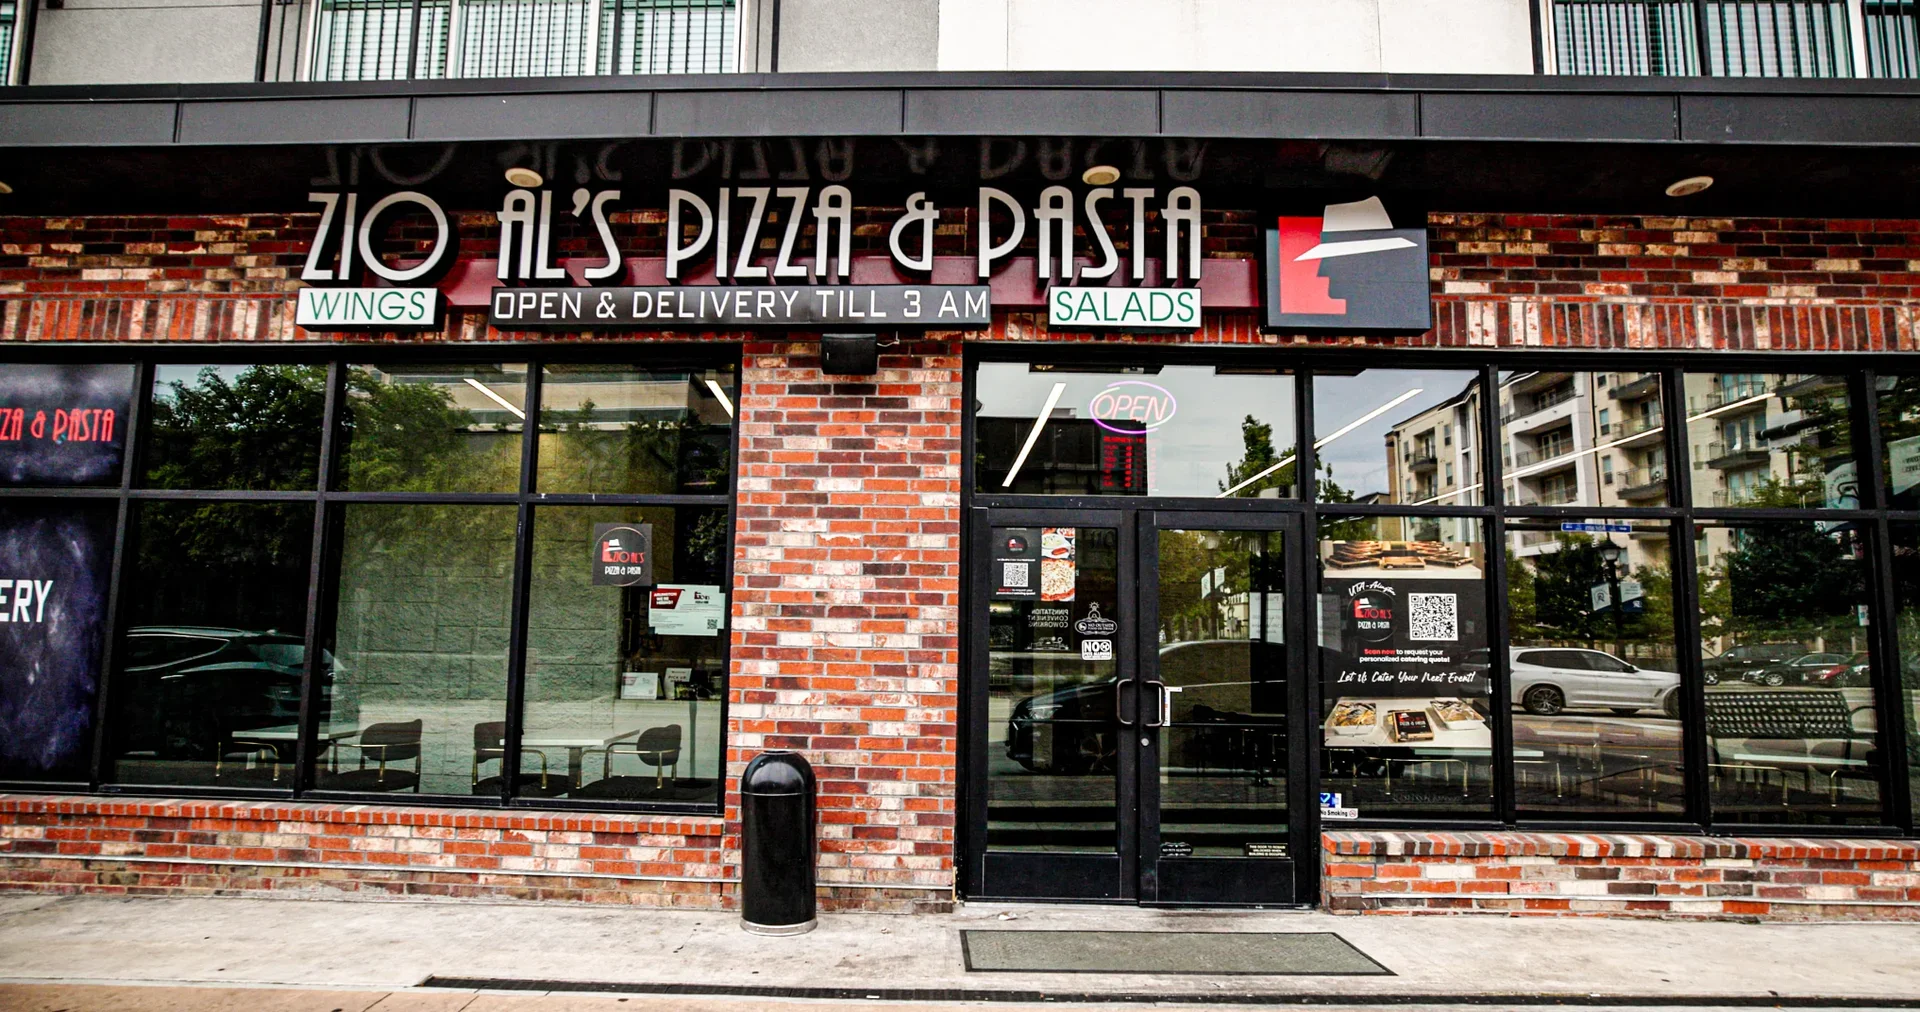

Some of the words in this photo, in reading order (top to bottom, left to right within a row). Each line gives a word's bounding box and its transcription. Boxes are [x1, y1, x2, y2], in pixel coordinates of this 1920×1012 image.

[301, 191, 449, 281] ZIO
[496, 187, 621, 280] AL'S
[666, 184, 852, 279] PIZZA
[889, 191, 940, 270] &
[978, 185, 1201, 280] PASTA
[309, 290, 426, 321] WINGS
[494, 291, 582, 319] OPEN
[596, 292, 617, 319] &
[632, 290, 799, 319] DELIVERY
[821, 290, 887, 318] TILL
[903, 291, 921, 318] 3
[938, 291, 987, 318] AM
[1055, 291, 1195, 322] SALADS
[1094, 394, 1168, 421] OPEN
[0, 407, 24, 441] ZA
[30, 410, 46, 439] &
[52, 407, 115, 442] PASTA
[1084, 641, 1100, 652] NO
[1359, 656, 1399, 664] personalized
[1400, 656, 1428, 664] catering
[1429, 656, 1450, 664] quote!
[1337, 670, 1356, 683] Let
[1371, 670, 1394, 683] Cater
[1397, 670, 1418, 683] Your
[1421, 671, 1447, 684] Next
[1327, 809, 1348, 817] Smoking
